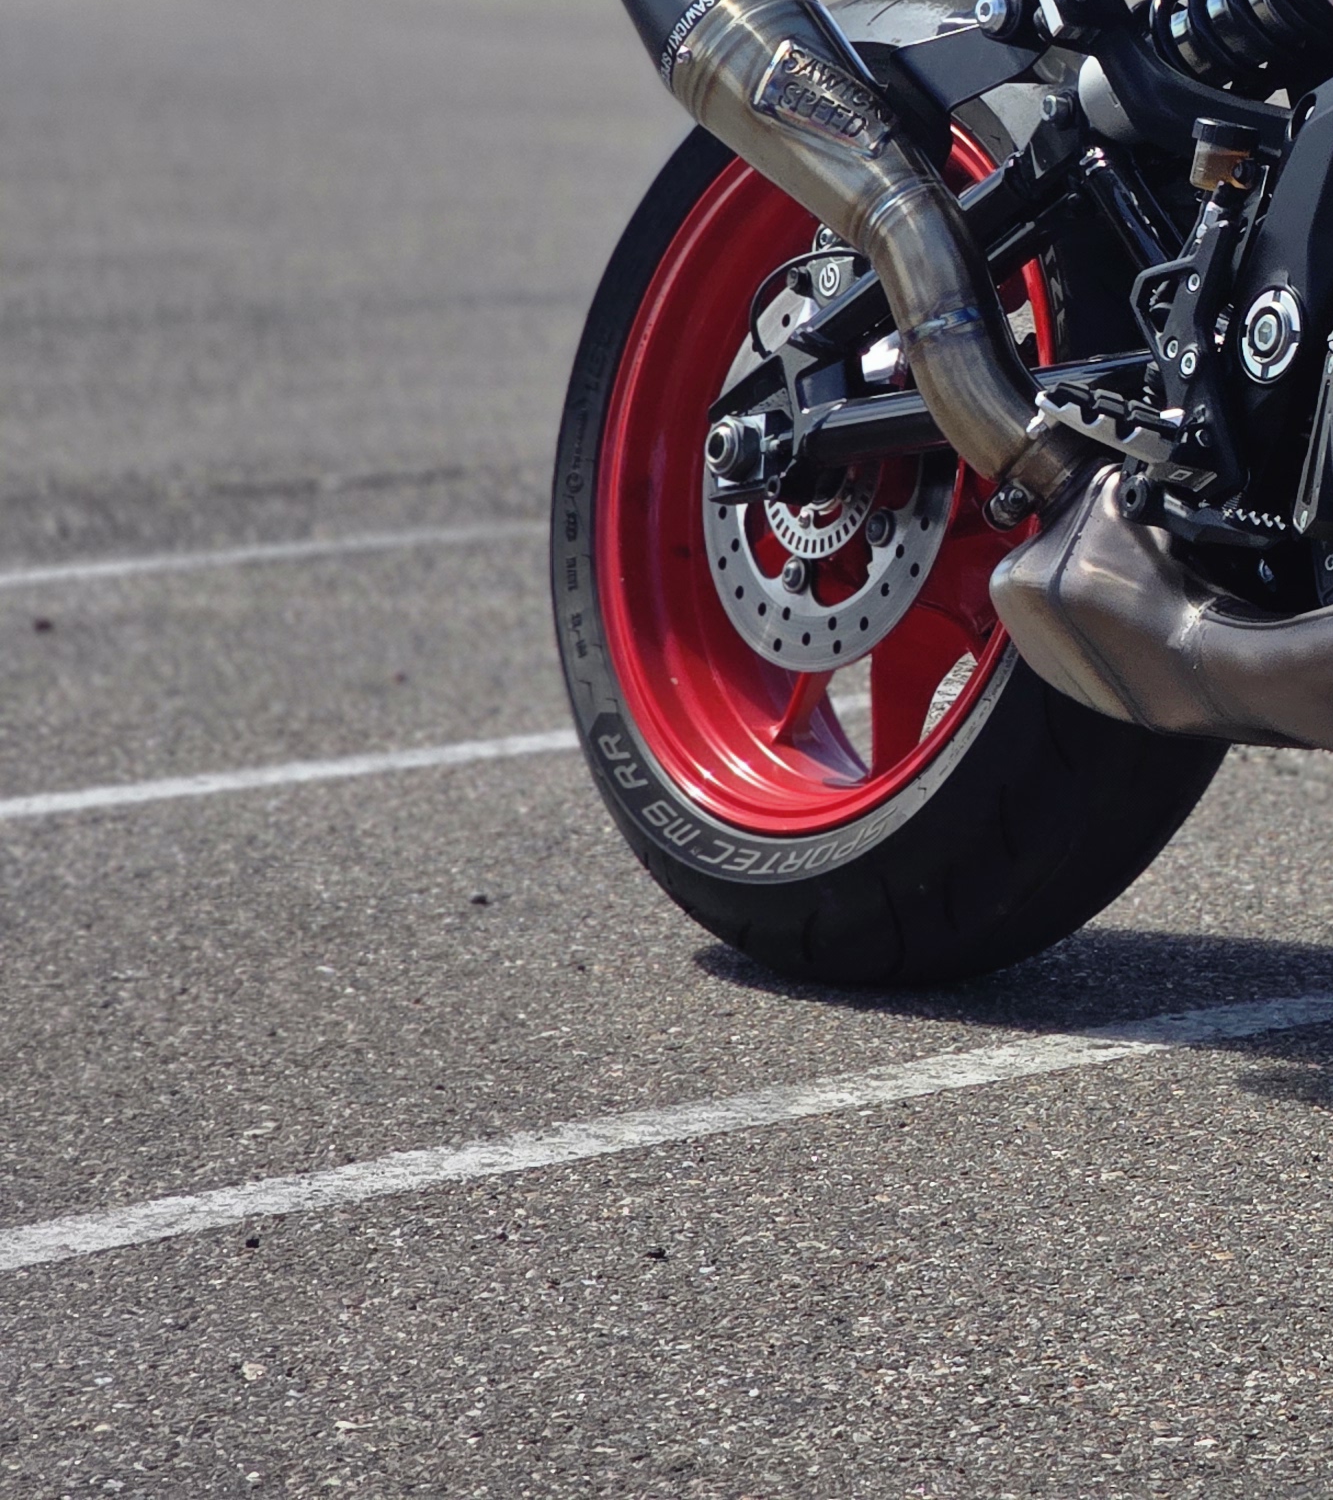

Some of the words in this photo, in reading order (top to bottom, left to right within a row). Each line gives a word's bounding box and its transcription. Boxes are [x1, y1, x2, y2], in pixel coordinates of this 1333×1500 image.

[778, 81, 870, 138] SPEED
[597, 734, 649, 790] RR
[697, 805, 897, 875] SPORTEC
